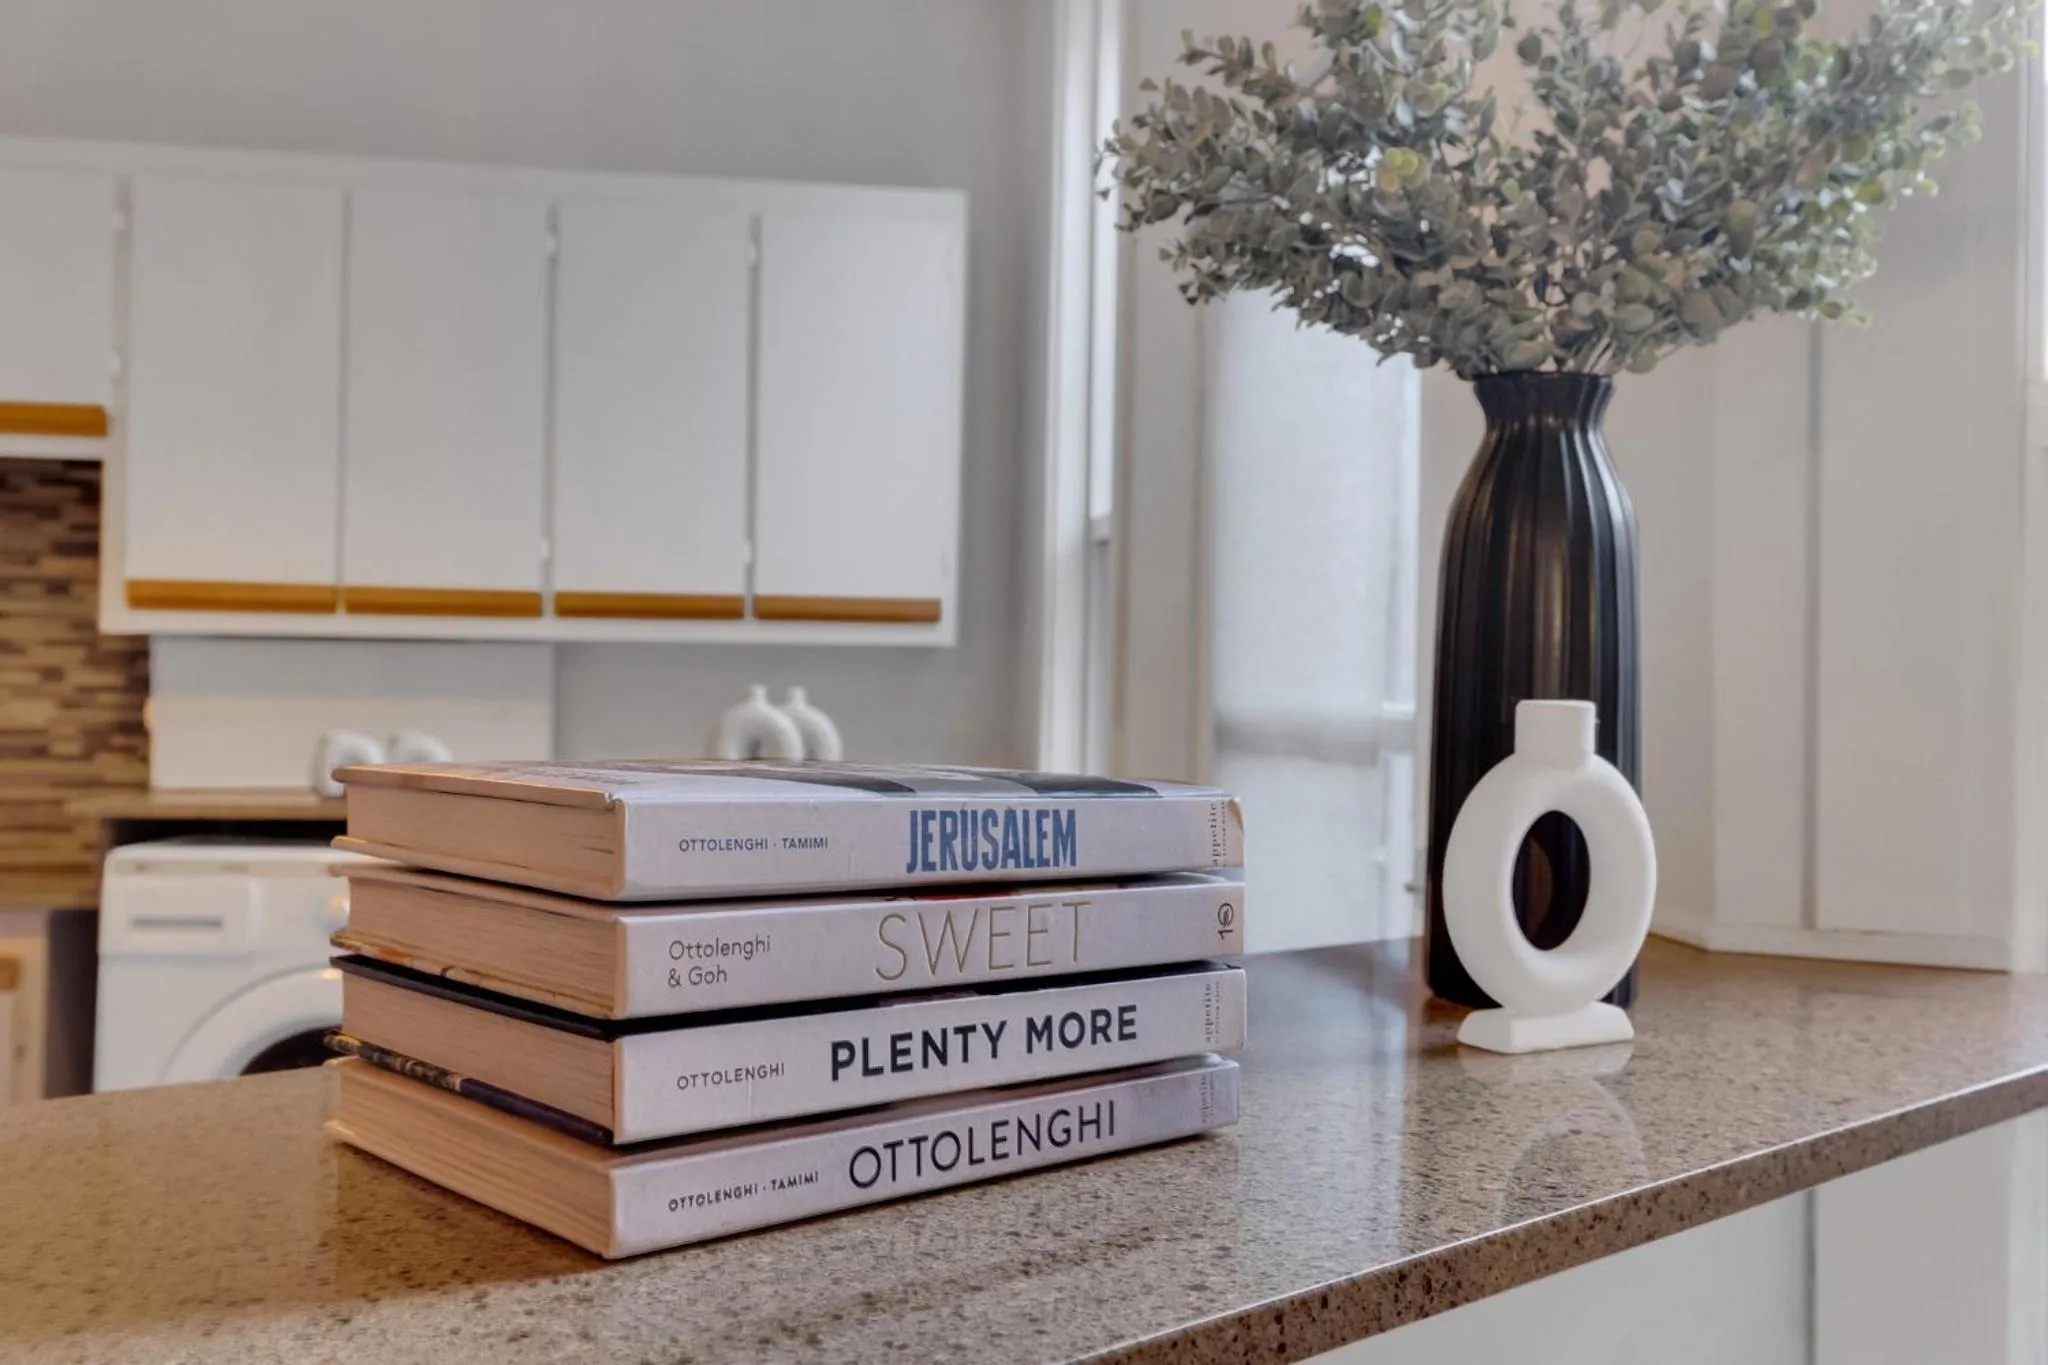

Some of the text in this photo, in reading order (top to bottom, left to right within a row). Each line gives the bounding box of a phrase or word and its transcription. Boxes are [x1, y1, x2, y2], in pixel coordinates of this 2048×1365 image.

[678, 836, 829, 852] OTTOLENGHI TAMIMI
[906, 808, 1077, 874] JERUSALEM
[1208, 803, 1221, 867] appetite
[668, 934, 771, 961] Ottolenghi
[875, 901, 1091, 981] SWEET
[667, 965, 728, 988] & Goh
[831, 1004, 1138, 1082] PLENTY MORE
[677, 1063, 785, 1090] OTTOLENGHI
[849, 1099, 1116, 1189] OTTOLENGHI
[668, 1171, 819, 1213] OTTOLENGHI TAMIMI
